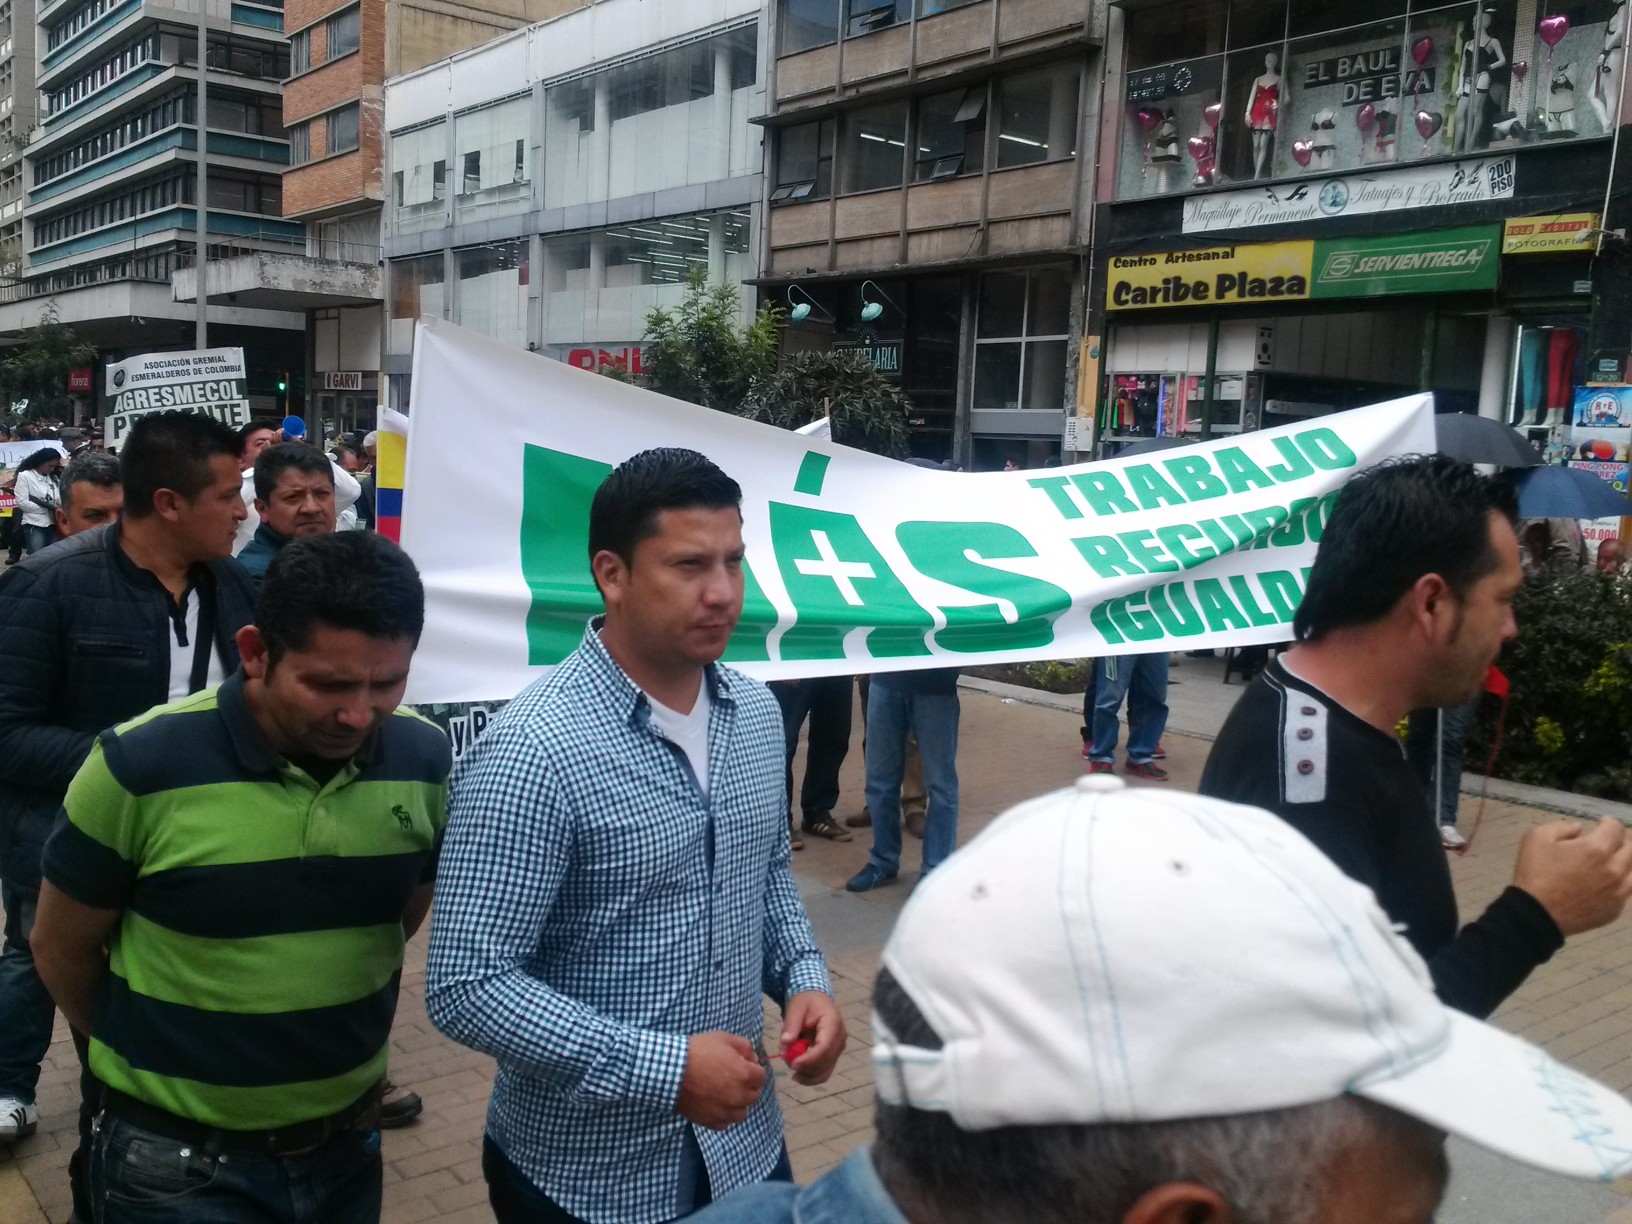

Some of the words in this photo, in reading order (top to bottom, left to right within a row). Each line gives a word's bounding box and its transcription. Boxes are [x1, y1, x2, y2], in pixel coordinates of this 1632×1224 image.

[1305, 62, 1330, 83] EL
[1337, 50, 1397, 78] BAUL
[1343, 80, 1373, 103] DE
[1381, 71, 1431, 97] EVA
[1489, 160, 1511, 181] 2DO
[1491, 175, 1512, 195] PISO
[1183, 199, 1241, 229] Maquillaje
[1244, 201, 1318, 226] Permanente
[1114, 257, 1157, 268] Centro
[1165, 247, 1235, 264] Artesanal
[1354, 248, 1482, 273] SERVIENTREGA
[1113, 276, 1209, 306] Caribe
[1215, 272, 1306, 300] Plaza
[131, 368, 191, 382] ESMERALDEROS
[193, 368, 203, 376] DE
[205, 365, 241, 375] COLOMBIA
[144, 358, 191, 370] ASOCIACIÓN
[193, 355, 226, 365] GREMIAL
[333, 373, 359, 388] GARVI
[113, 381, 242, 414] AGRESMECOL
[1026, 427, 1356, 519] TRABAJO
[1597, 463, 1624, 471] PONG
[1090, 566, 1314, 645] IGUALD
